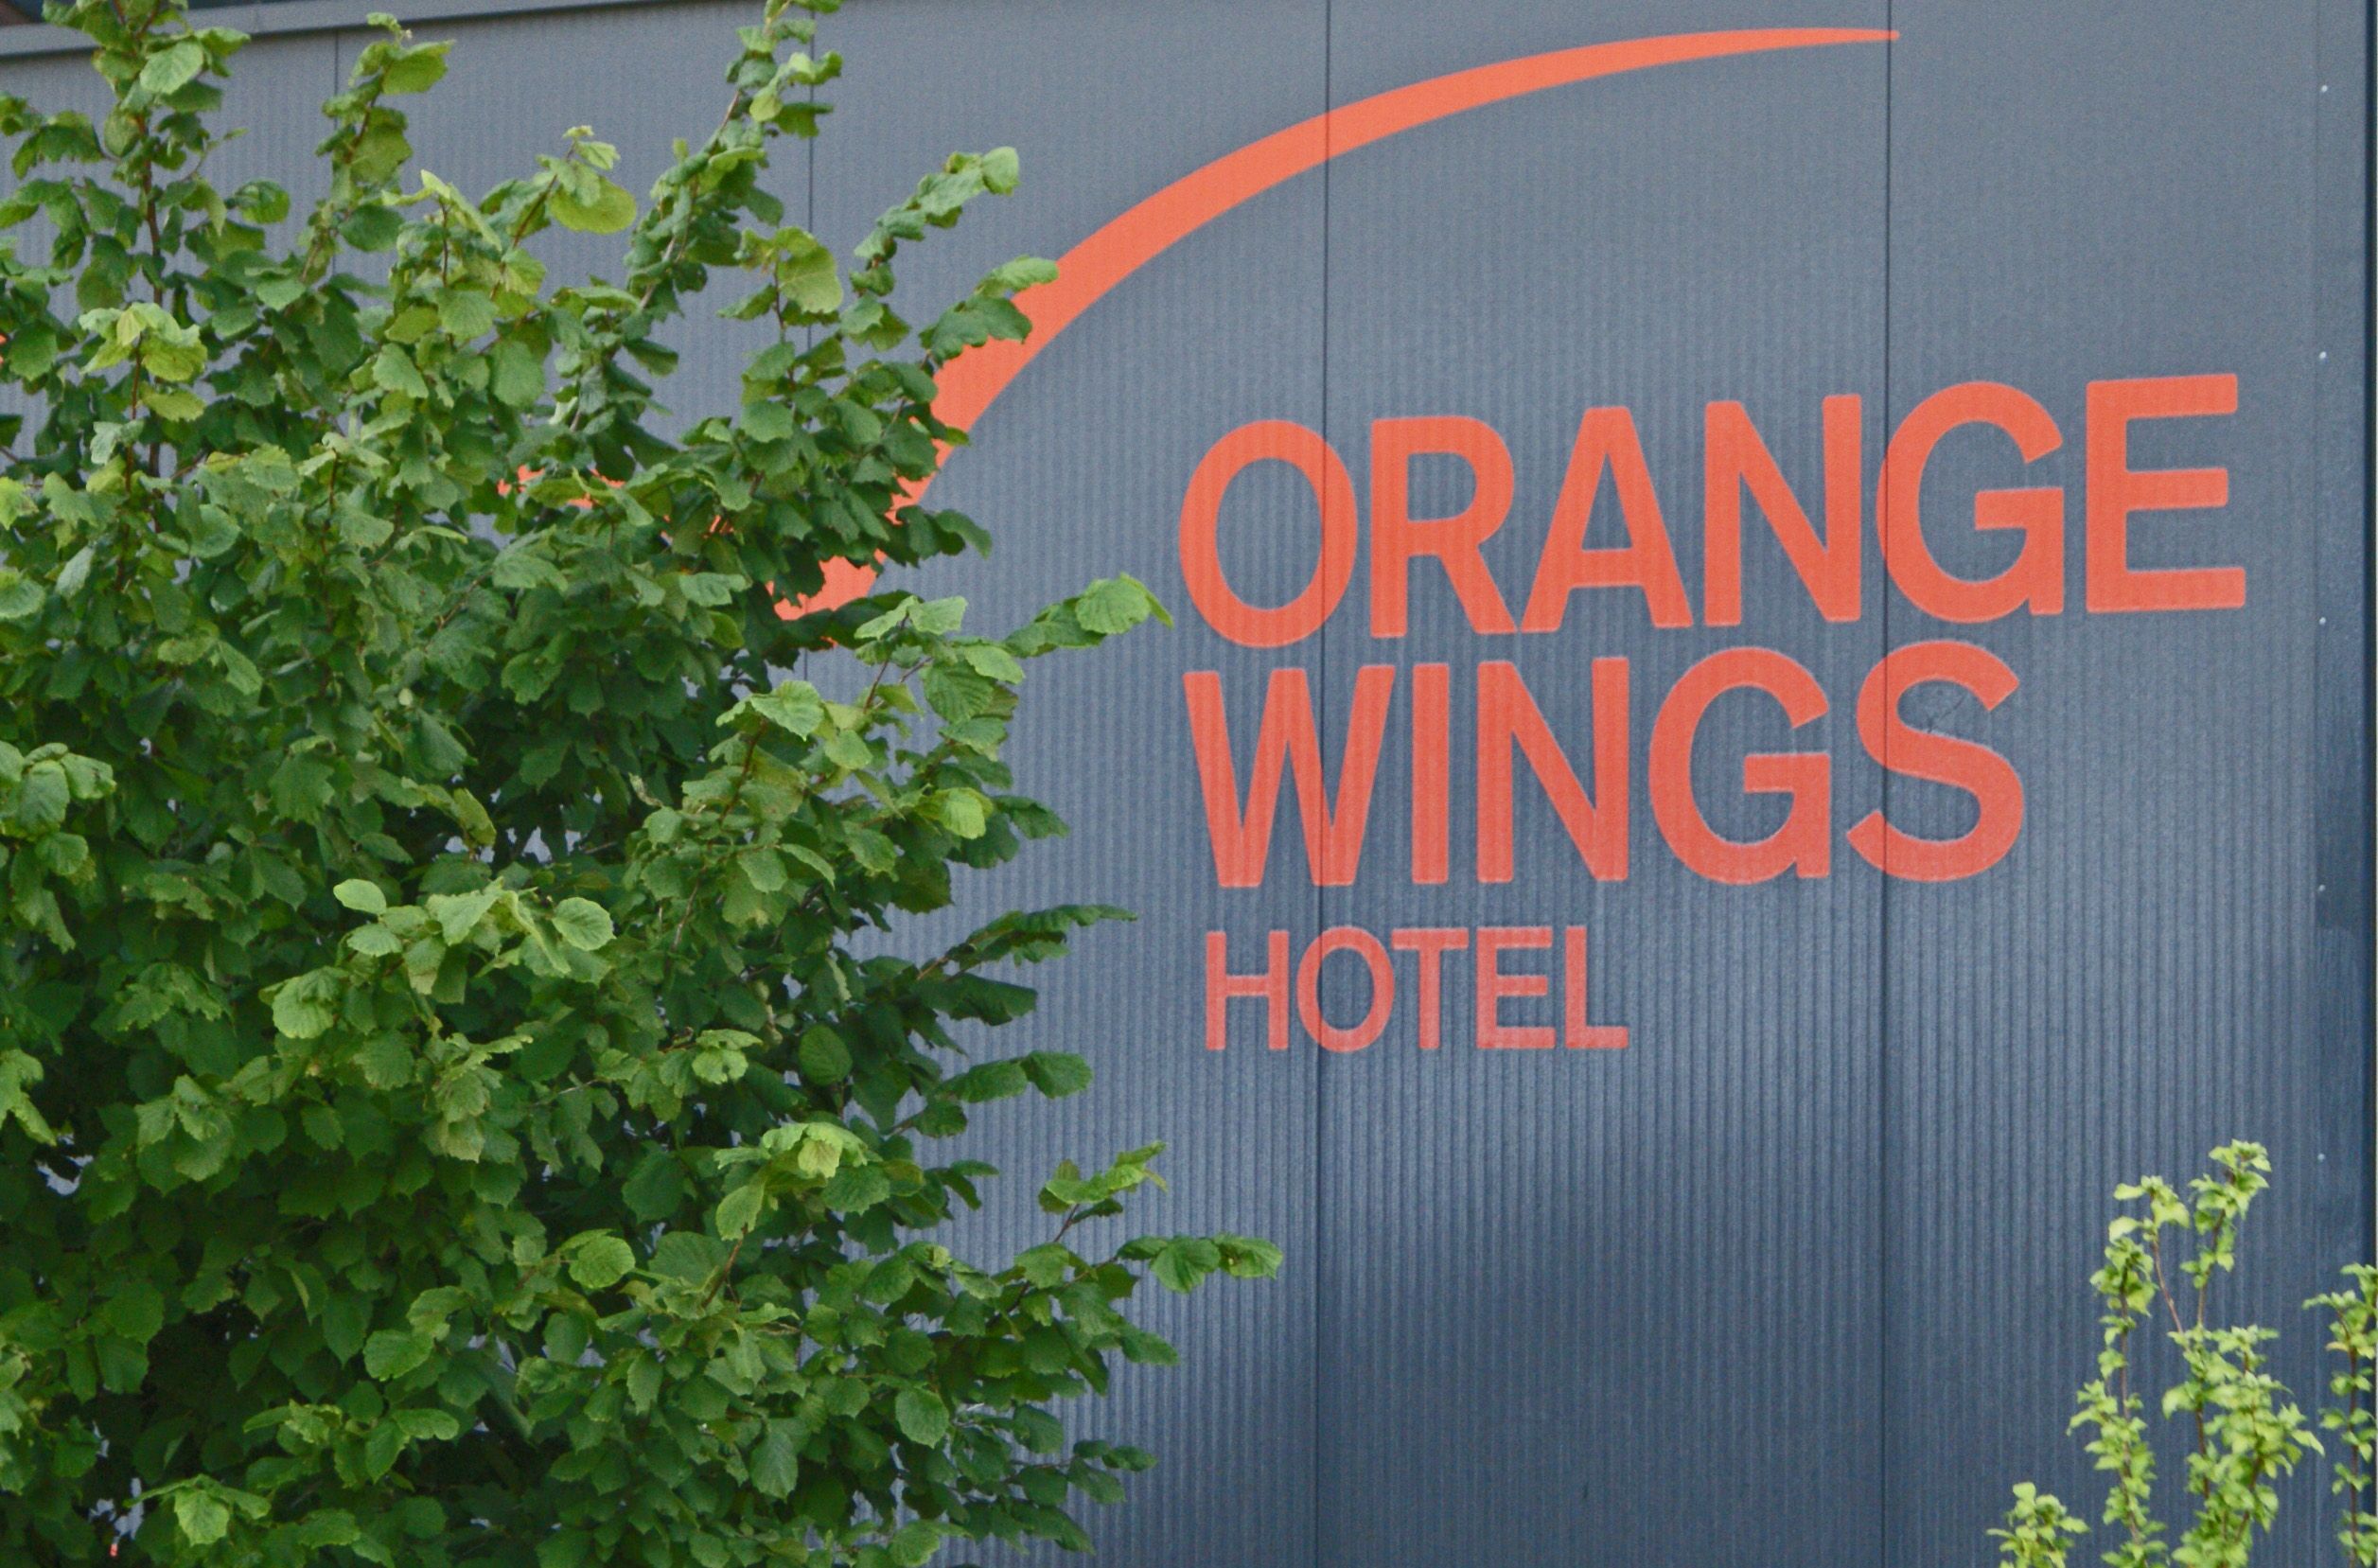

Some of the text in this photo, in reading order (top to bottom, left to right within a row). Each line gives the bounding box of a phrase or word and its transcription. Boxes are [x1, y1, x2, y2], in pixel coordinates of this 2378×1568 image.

[1178, 374, 2246, 648] ORANGE
[1183, 641, 2024, 888] WINGS
[1205, 925, 1629, 1052] HOTEL
